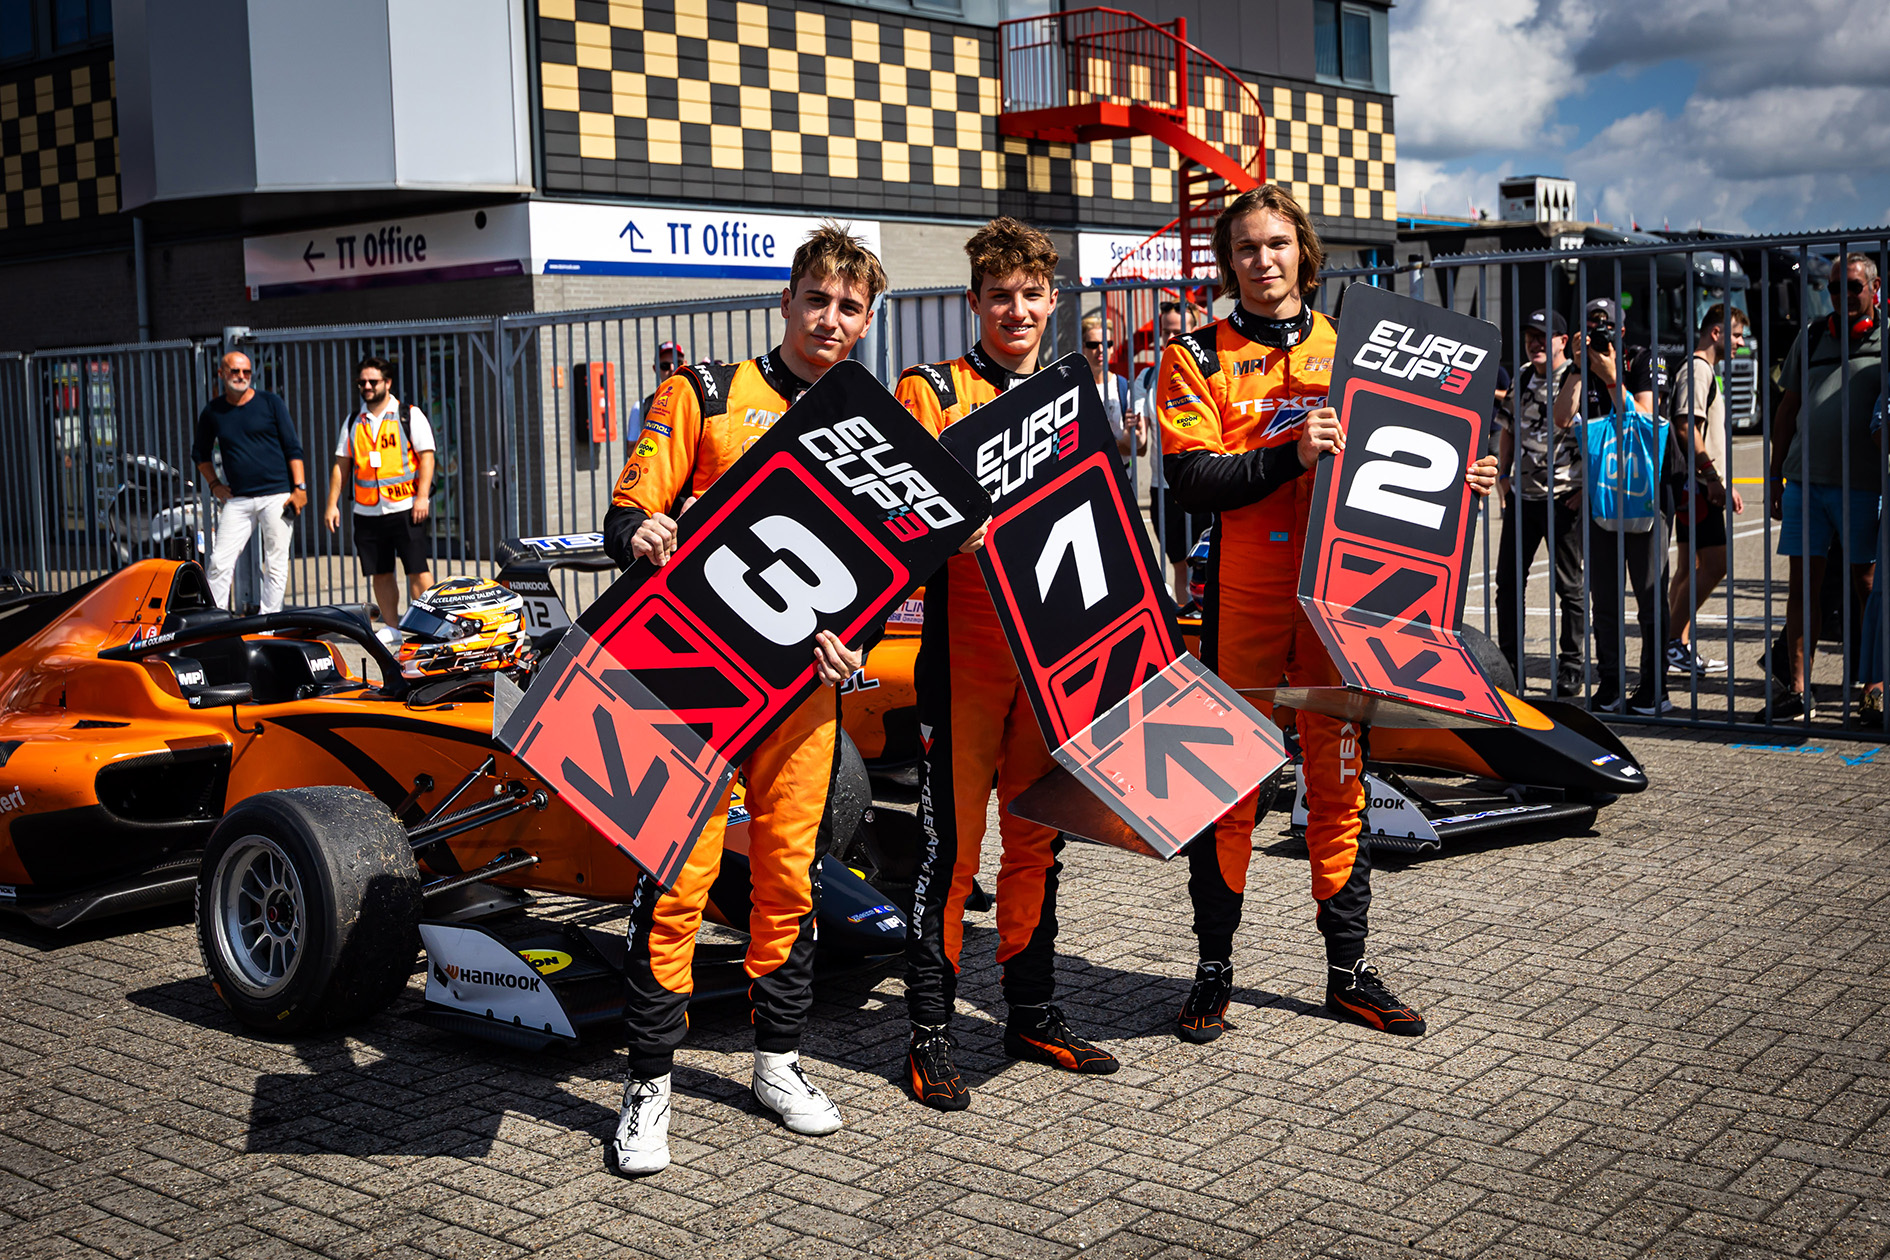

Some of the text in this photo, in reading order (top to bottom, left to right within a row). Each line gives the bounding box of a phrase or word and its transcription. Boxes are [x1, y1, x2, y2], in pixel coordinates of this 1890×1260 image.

[336, 226, 427, 270] TT Office
[667, 221, 776, 259] TT Office
[1182, 335, 1210, 365] HRX
[1353, 343, 1446, 381] CUP
[1369, 319, 1489, 372] EURO
[694, 364, 719, 399] HRX
[918, 364, 950, 393] HRX
[381, 432, 397, 449] 54
[977, 385, 1080, 478] EURO
[798, 427, 905, 510] CUP
[833, 416, 965, 530] EURO
[979, 436, 1053, 504] CUP
[1345, 425, 1460, 531] 2
[703, 515, 858, 646] 3
[523, 600, 552, 628] 12
